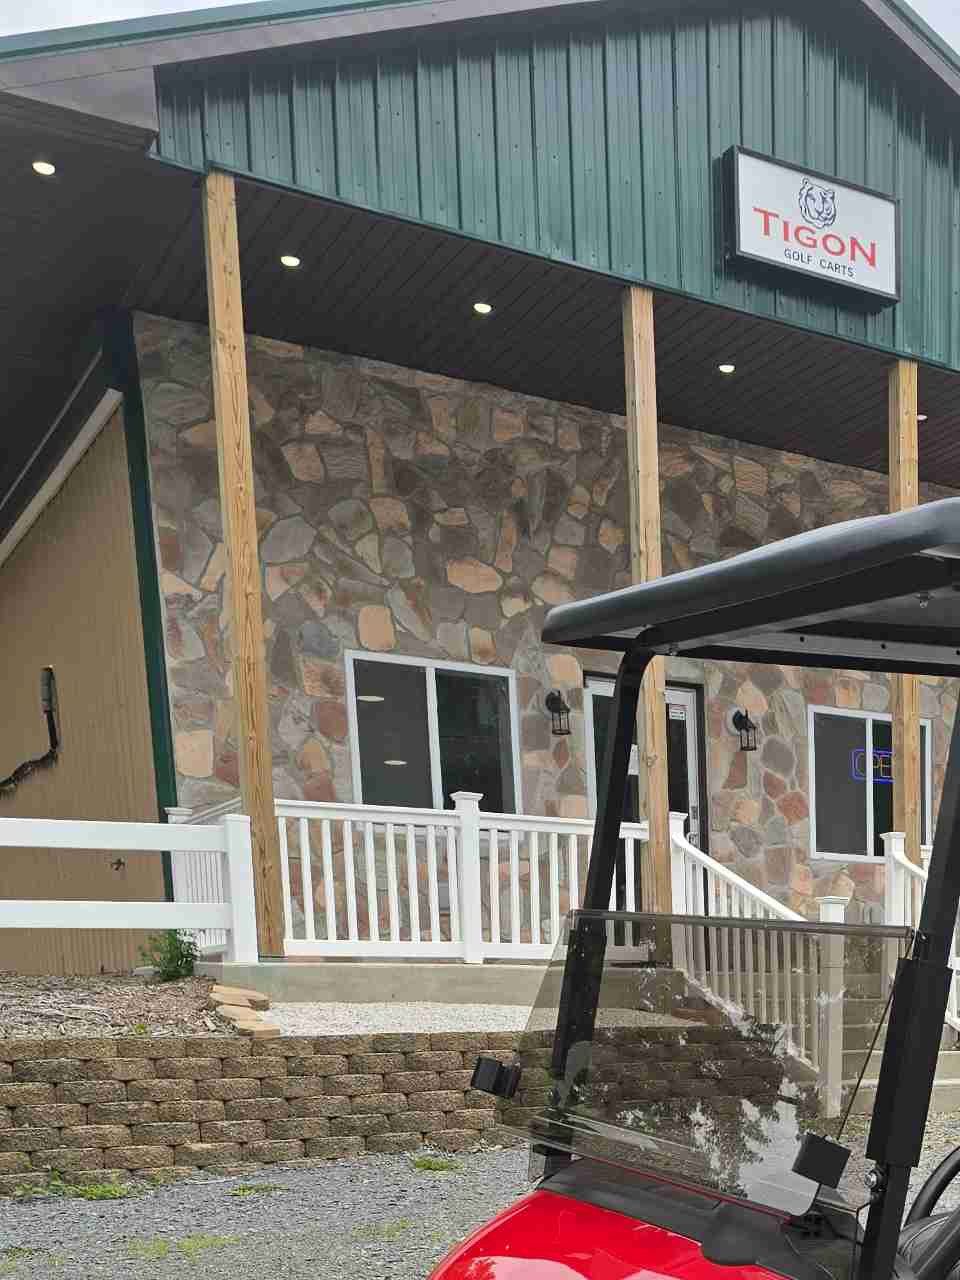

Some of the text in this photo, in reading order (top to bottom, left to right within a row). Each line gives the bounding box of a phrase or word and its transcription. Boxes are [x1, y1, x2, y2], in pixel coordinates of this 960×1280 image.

[752, 206, 877, 267] TIGON
[784, 248, 855, 278] GOLF CARTS
